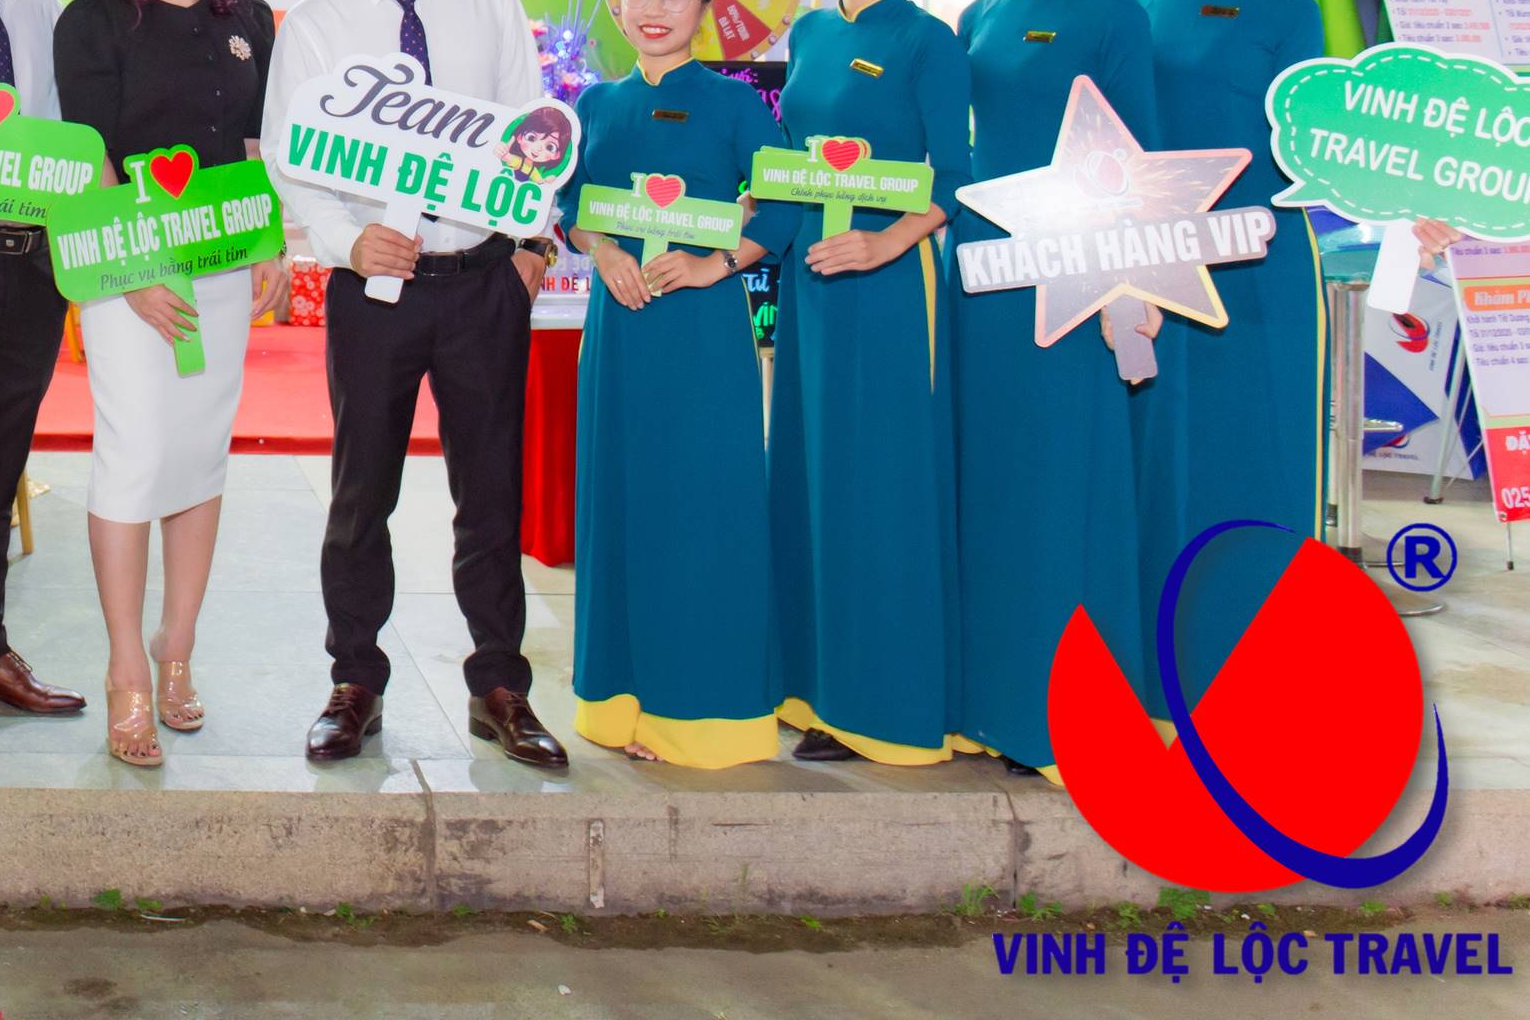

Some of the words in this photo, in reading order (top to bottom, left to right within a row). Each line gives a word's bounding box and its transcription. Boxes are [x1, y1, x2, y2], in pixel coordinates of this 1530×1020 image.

[320, 64, 496, 149] Team
[1343, 80, 1413, 123] VINH
[1423, 93, 1467, 136] ĐỆ
[30, 155, 93, 196] GROUP
[288, 123, 388, 194] VINH
[396, 153, 457, 212] ĐỆ
[461, 168, 542, 226] LỘC
[763, 167, 787, 183] VINH
[789, 166, 807, 186] ĐỆ
[809, 166, 832, 187] LỘC
[834, 173, 878, 189] TRAVEL
[880, 176, 918, 192] GROUP
[1310, 128, 1423, 180] TRAVEL
[18, 198, 47, 217] tim
[57, 230, 99, 271] VINH
[103, 217, 128, 268] ĐỆ
[133, 210, 164, 262] LỘC
[163, 205, 221, 249] TRAVEL
[222, 193, 272, 237] GROUP
[963, 227, 1086, 286] KHÁCH
[1095, 212, 1198, 272] HÀNG
[1208, 208, 1272, 255] VIP
